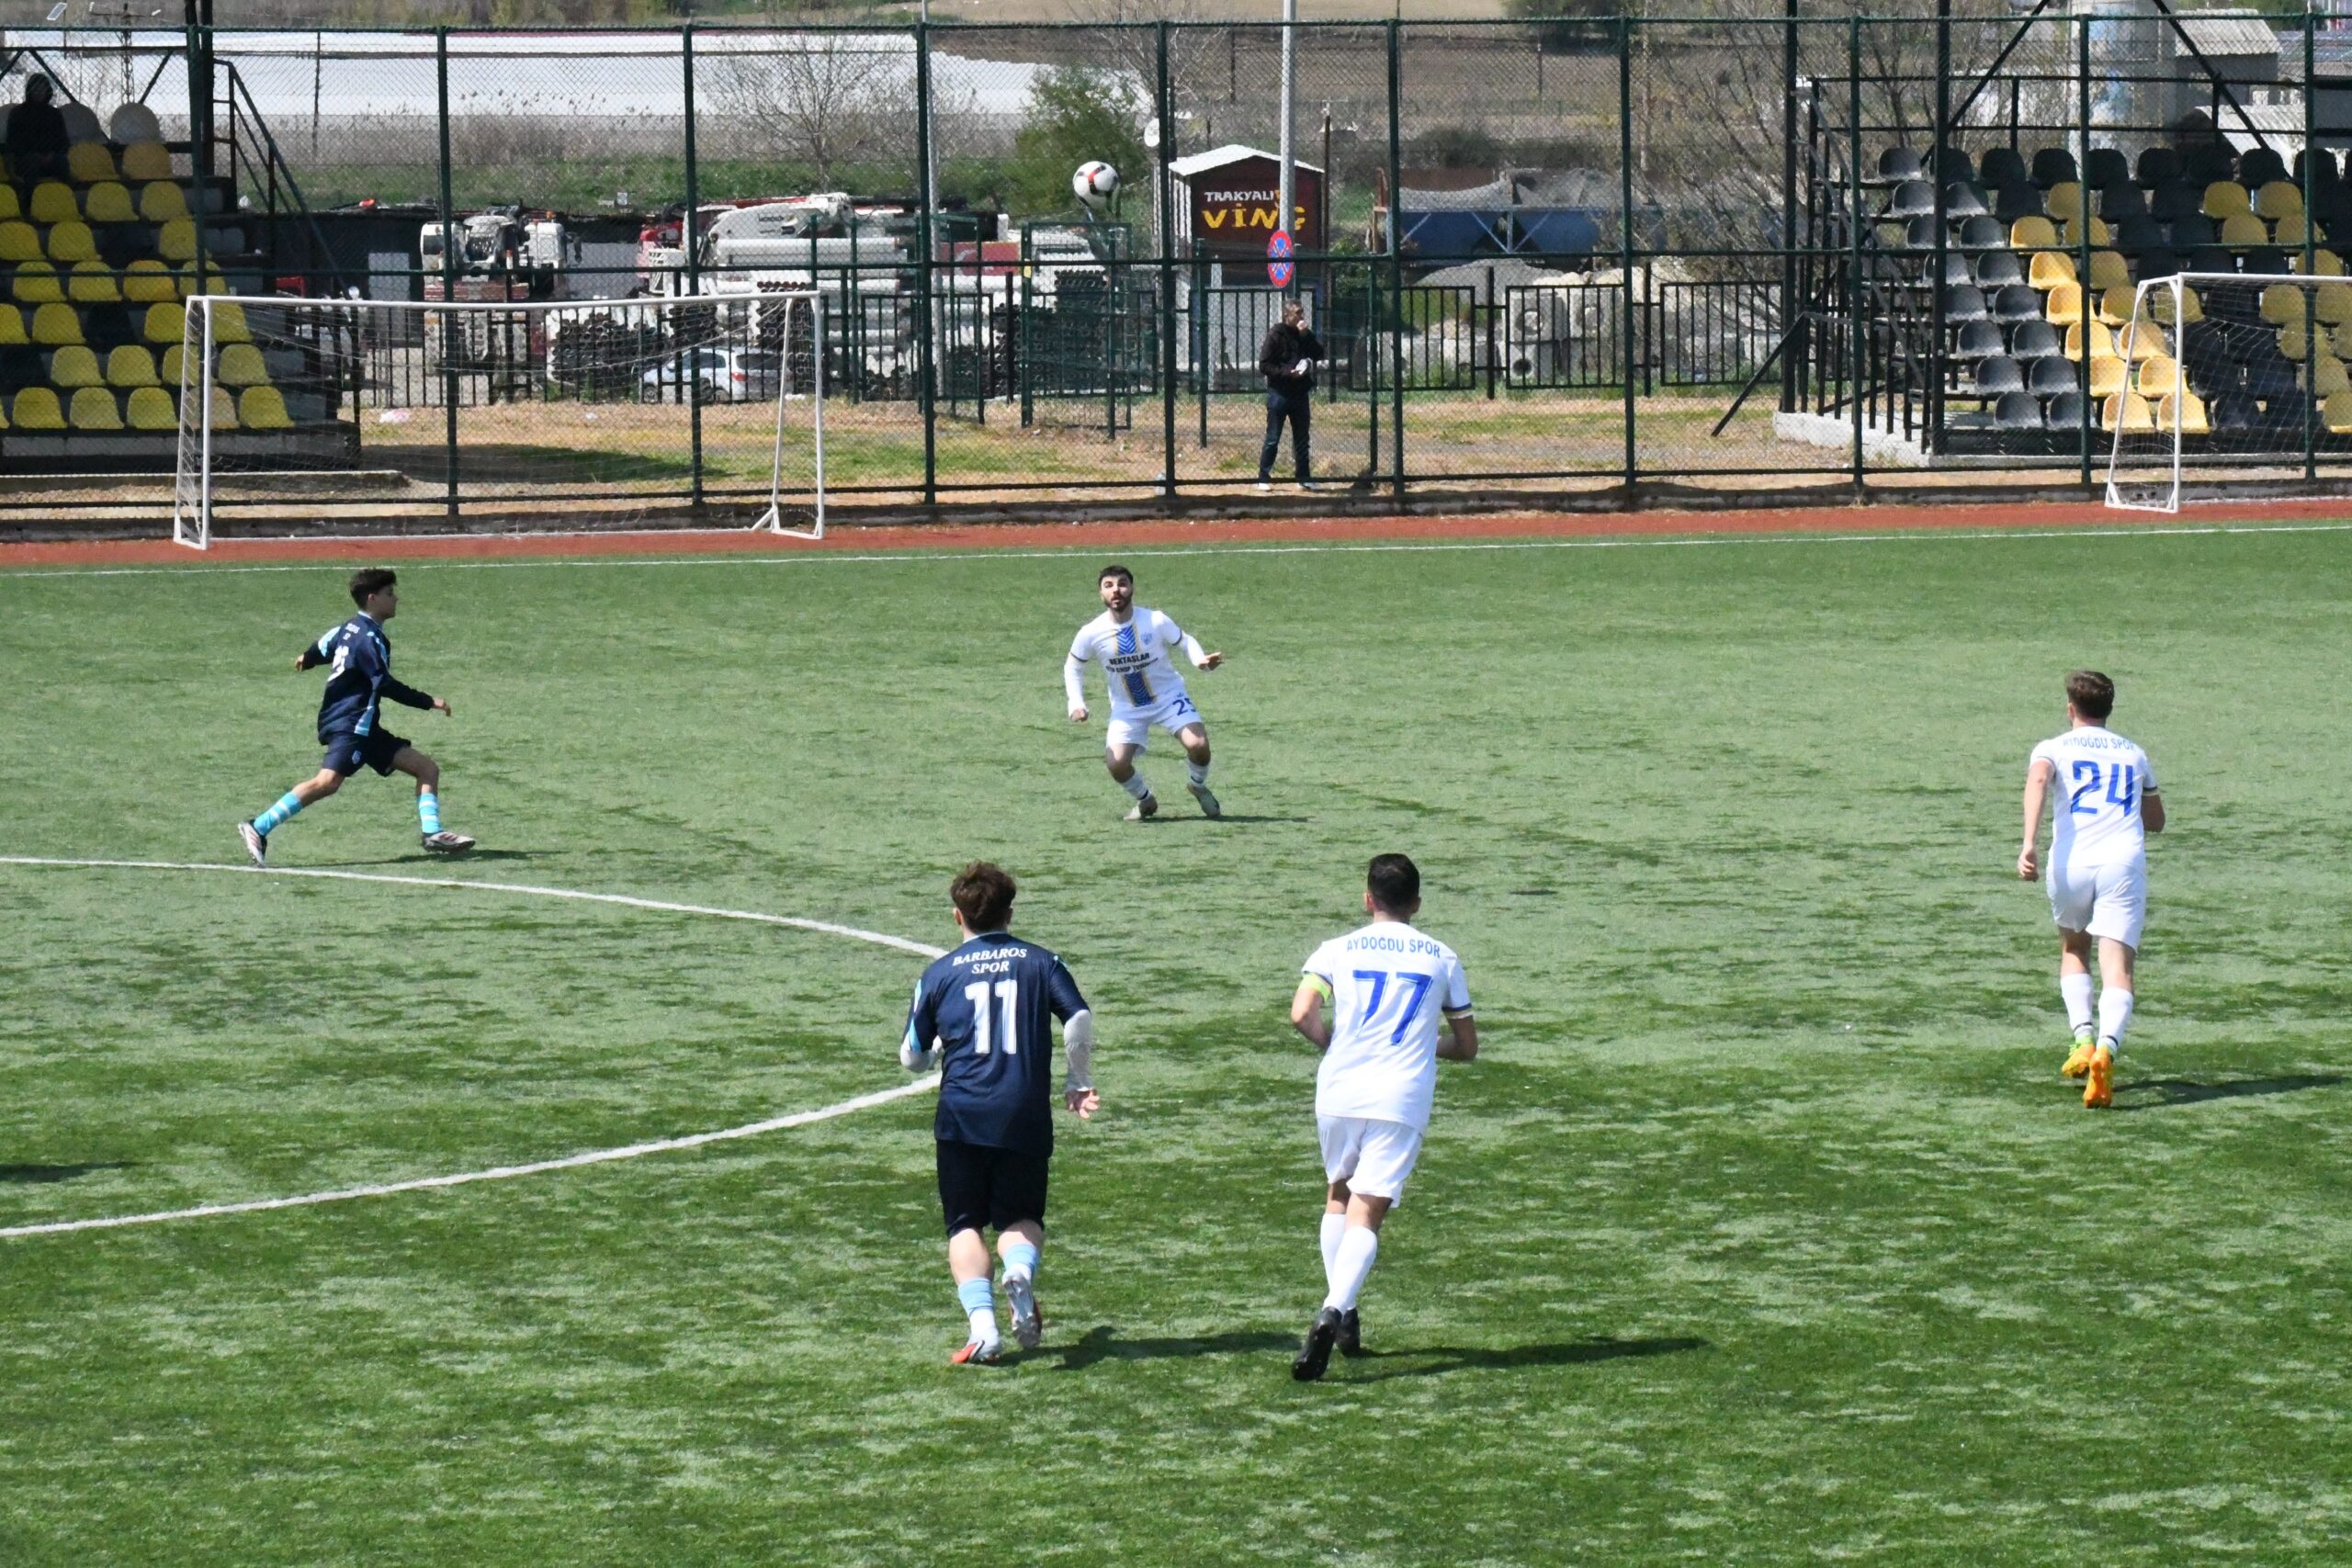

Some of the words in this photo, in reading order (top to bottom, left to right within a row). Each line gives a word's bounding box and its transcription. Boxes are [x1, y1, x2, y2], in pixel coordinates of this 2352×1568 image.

[1204, 190, 1274, 202] TRAKYALI
[2070, 760, 2134, 818] 24
[952, 947, 1027, 965] BARBAROS
[1408, 939, 1441, 959] SPOR
[971, 961, 1010, 975] SPOR
[965, 978, 1018, 1055] 11
[1352, 969, 1433, 1046] 77
